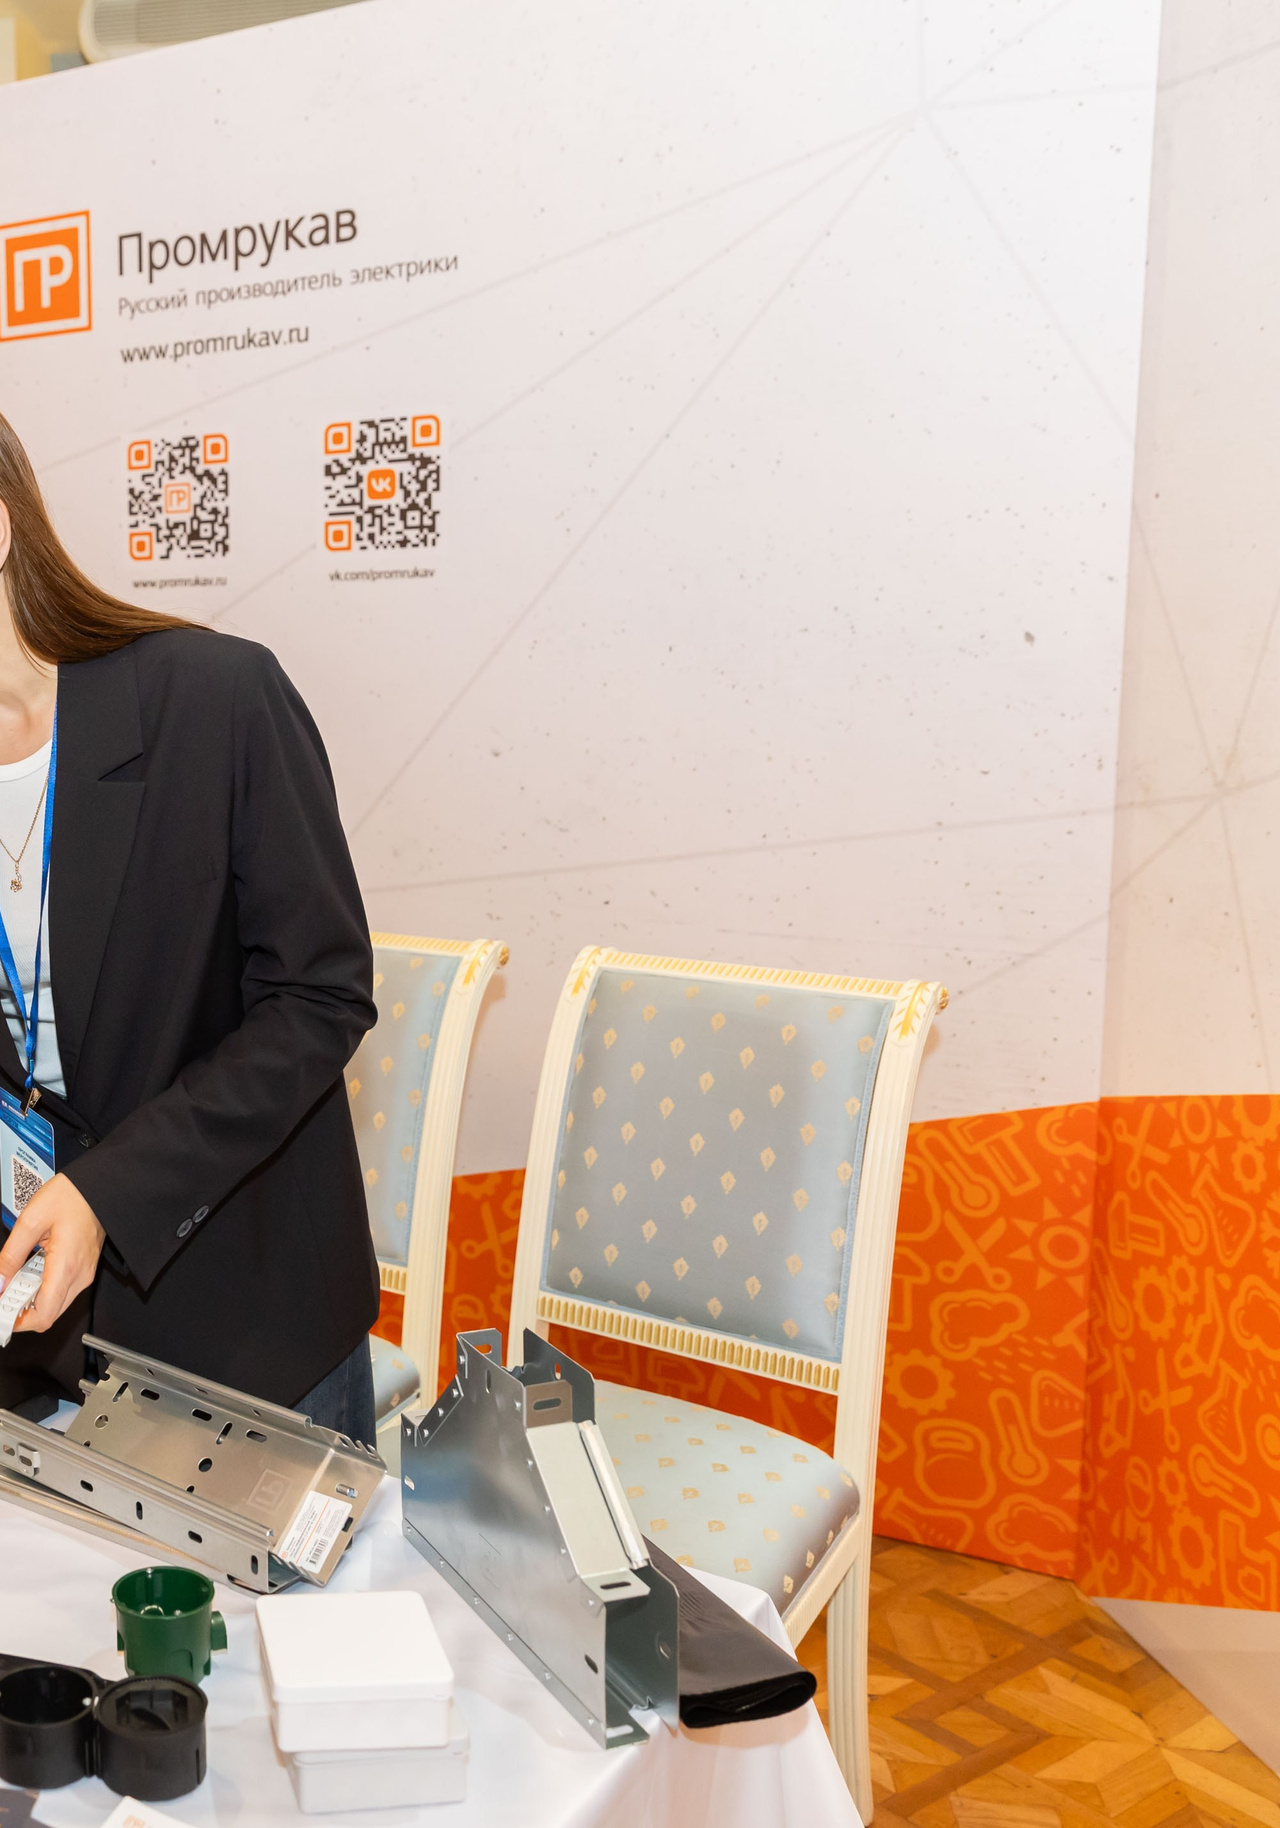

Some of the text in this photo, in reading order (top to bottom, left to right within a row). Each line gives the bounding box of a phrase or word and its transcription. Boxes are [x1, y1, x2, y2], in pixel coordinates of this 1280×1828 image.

[118, 207, 358, 284] Промрукав
[119, 255, 459, 319] Русский производитель электрики
[120, 326, 310, 363] www.promrukav.ru
[132, 574, 228, 589] www.promrukav.ru
[328, 564, 435, 582] vk.com/promrukav
